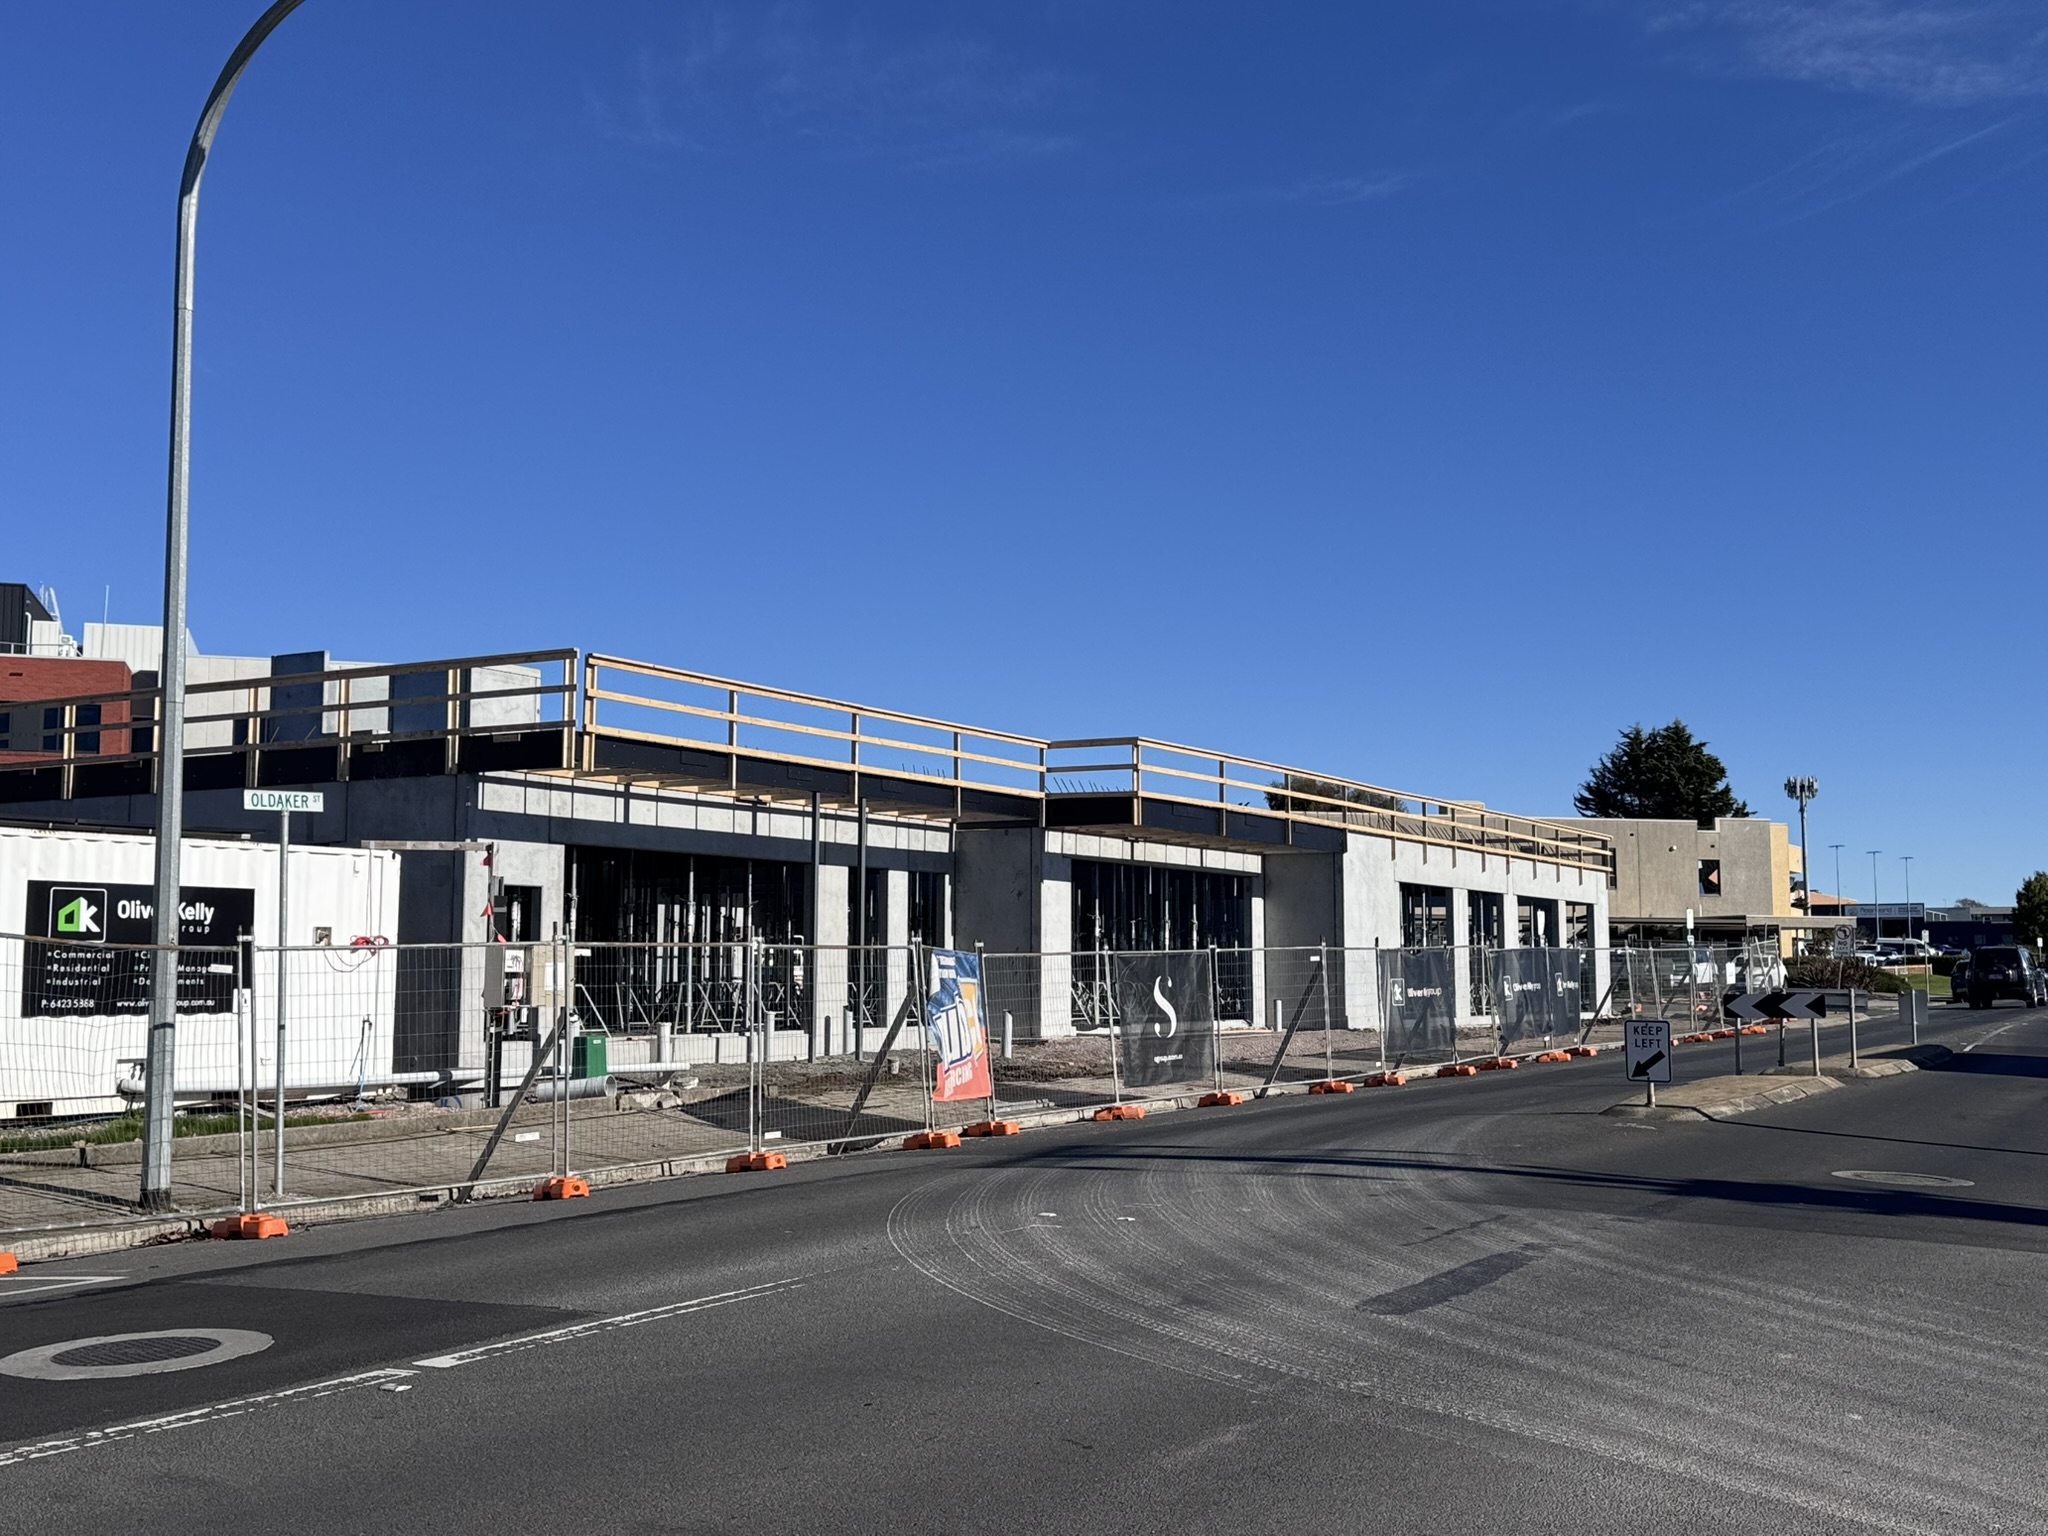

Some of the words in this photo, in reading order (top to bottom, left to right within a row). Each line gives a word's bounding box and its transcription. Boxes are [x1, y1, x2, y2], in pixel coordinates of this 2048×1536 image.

[251, 793, 309, 808] OLDAKER
[182, 925, 210, 935] roup
[53, 950, 114, 959] Commercial
[53, 963, 110, 972] Residential
[52, 977, 101, 986] Industrial
[1633, 1025, 1662, 1036] KEEP
[1634, 1038, 1662, 1048] LEFT
